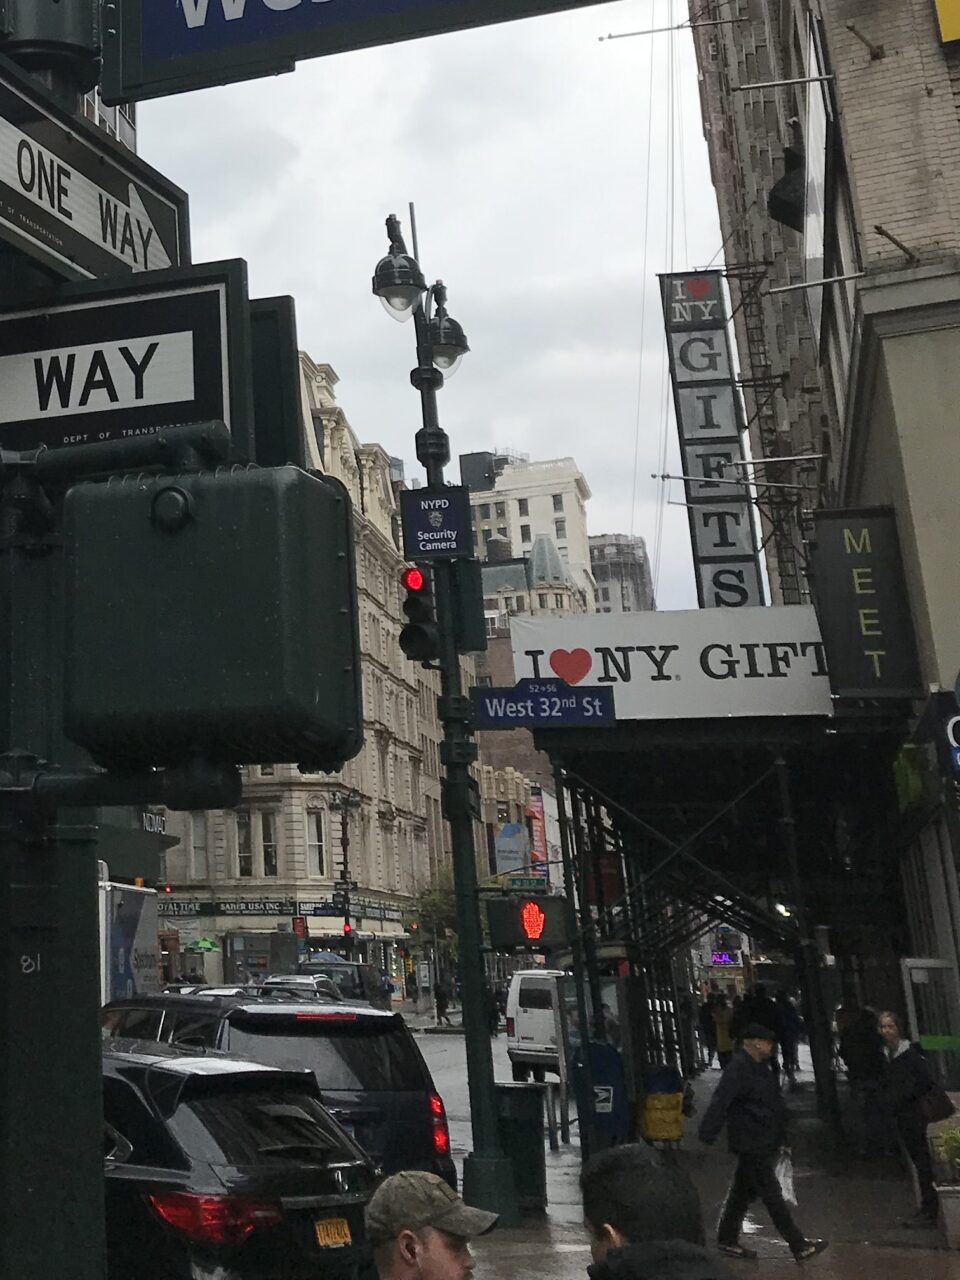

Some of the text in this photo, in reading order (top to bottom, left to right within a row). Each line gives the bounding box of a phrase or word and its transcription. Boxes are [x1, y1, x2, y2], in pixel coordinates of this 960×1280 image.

[17, 138, 153, 269] ONE WAY
[672, 280, 686, 299] I
[672, 300, 717, 321] NY
[34, 342, 160, 412] WAY
[64, 431, 111, 443] DEPT OF
[679, 337, 749, 607] GIFTS
[421, 500, 449, 509] NYPD
[417, 529, 457, 540] Security
[419, 541, 456, 550] Camera
[843, 528, 886, 678] MEET
[524, 650, 544, 678] I
[485, 696, 603, 717] West 32nd St
